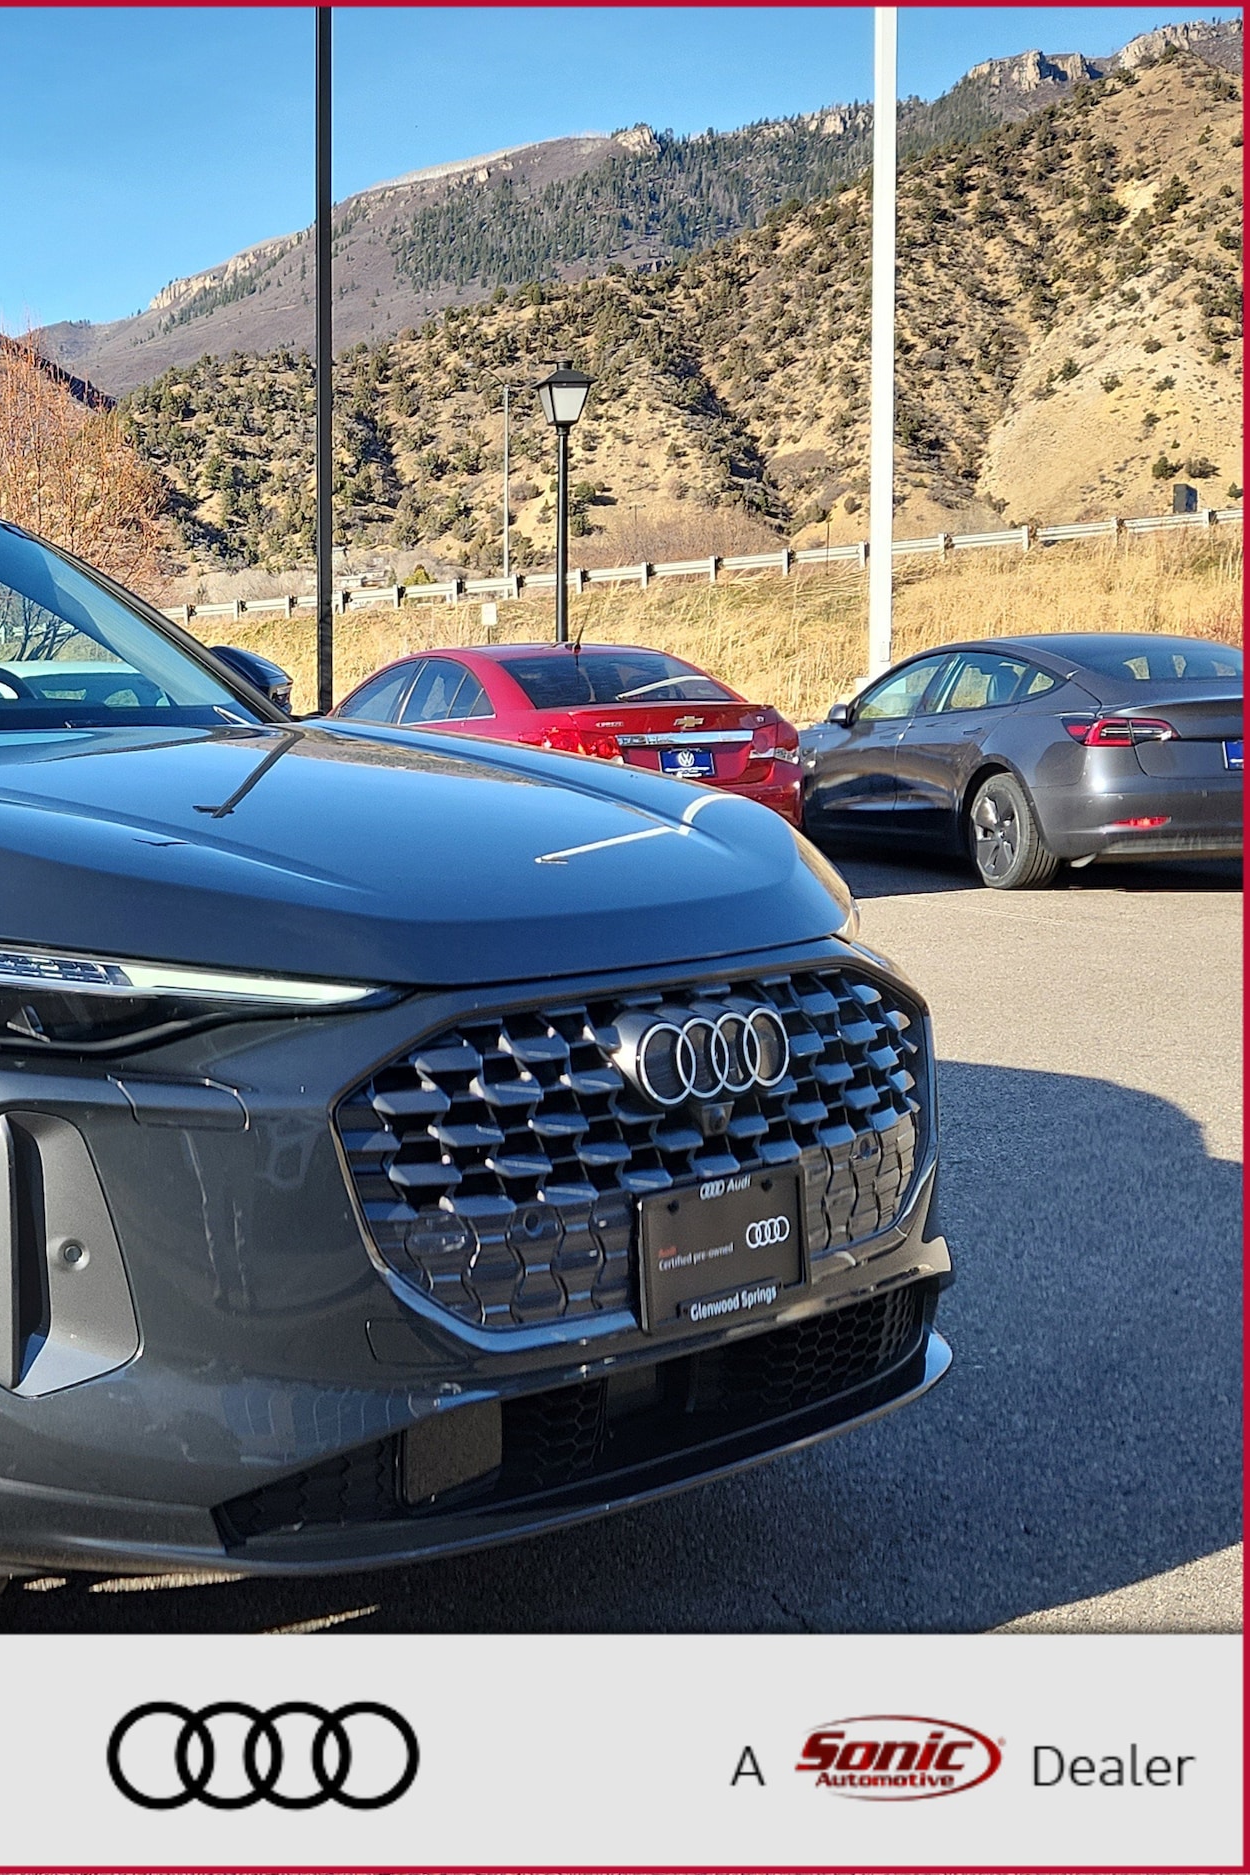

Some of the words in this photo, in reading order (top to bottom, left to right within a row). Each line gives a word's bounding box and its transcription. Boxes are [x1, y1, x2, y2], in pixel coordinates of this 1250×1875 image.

[727, 1175, 751, 1193] Audi
[659, 1252, 692, 1271] Certified
[693, 1242, 734, 1265] pre-owned
[690, 1292, 740, 1322] Glenwood
[741, 1286, 777, 1309] Springs
